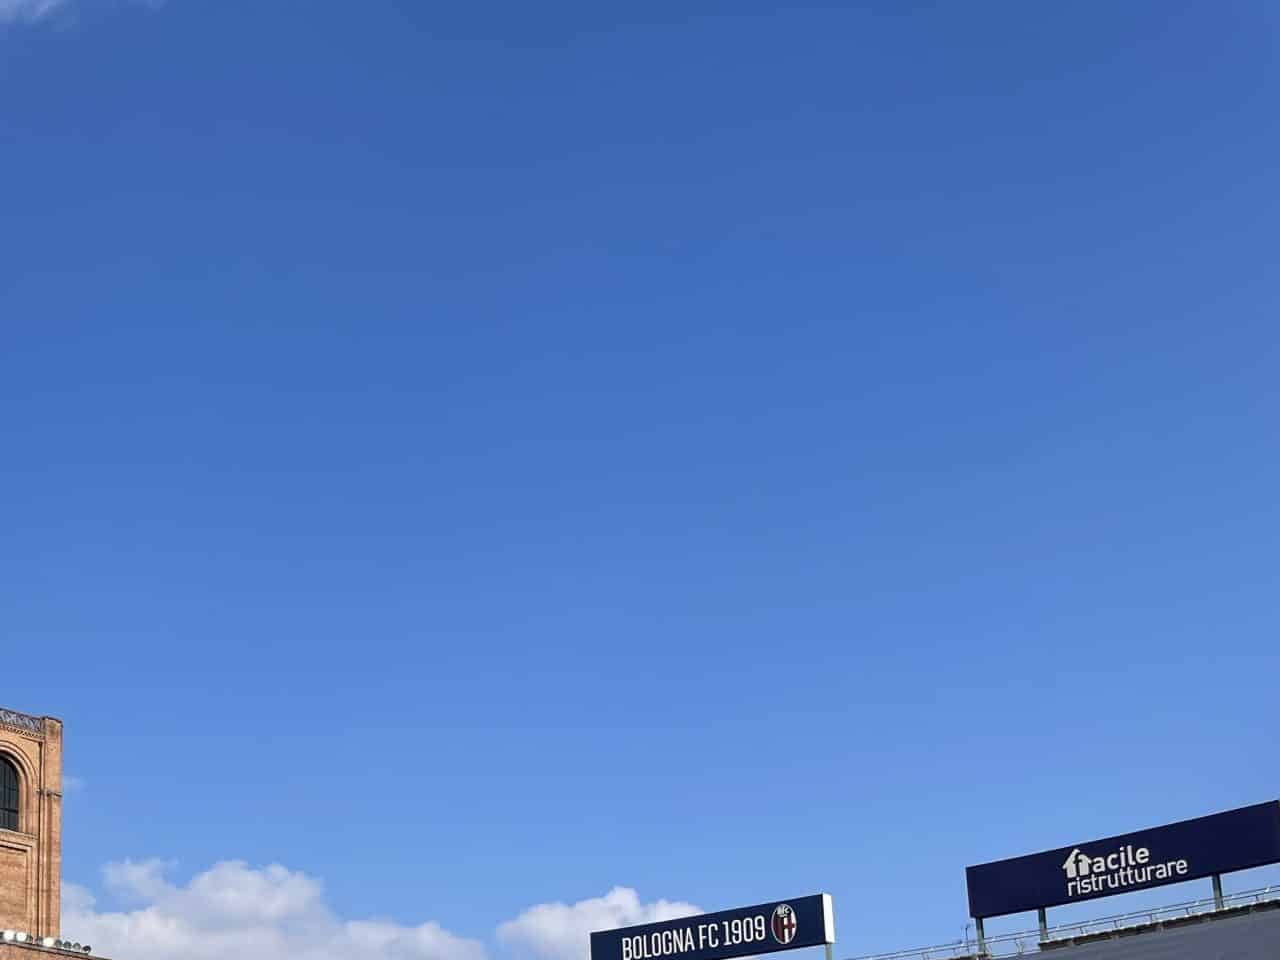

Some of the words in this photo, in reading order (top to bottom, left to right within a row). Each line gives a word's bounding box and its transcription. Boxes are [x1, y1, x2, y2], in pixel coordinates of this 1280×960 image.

[1067, 859, 1188, 897] ristrutturare
[622, 928, 695, 960] BOLOGNA
[698, 923, 719, 950] FC
[722, 914, 766, 946] 1909
